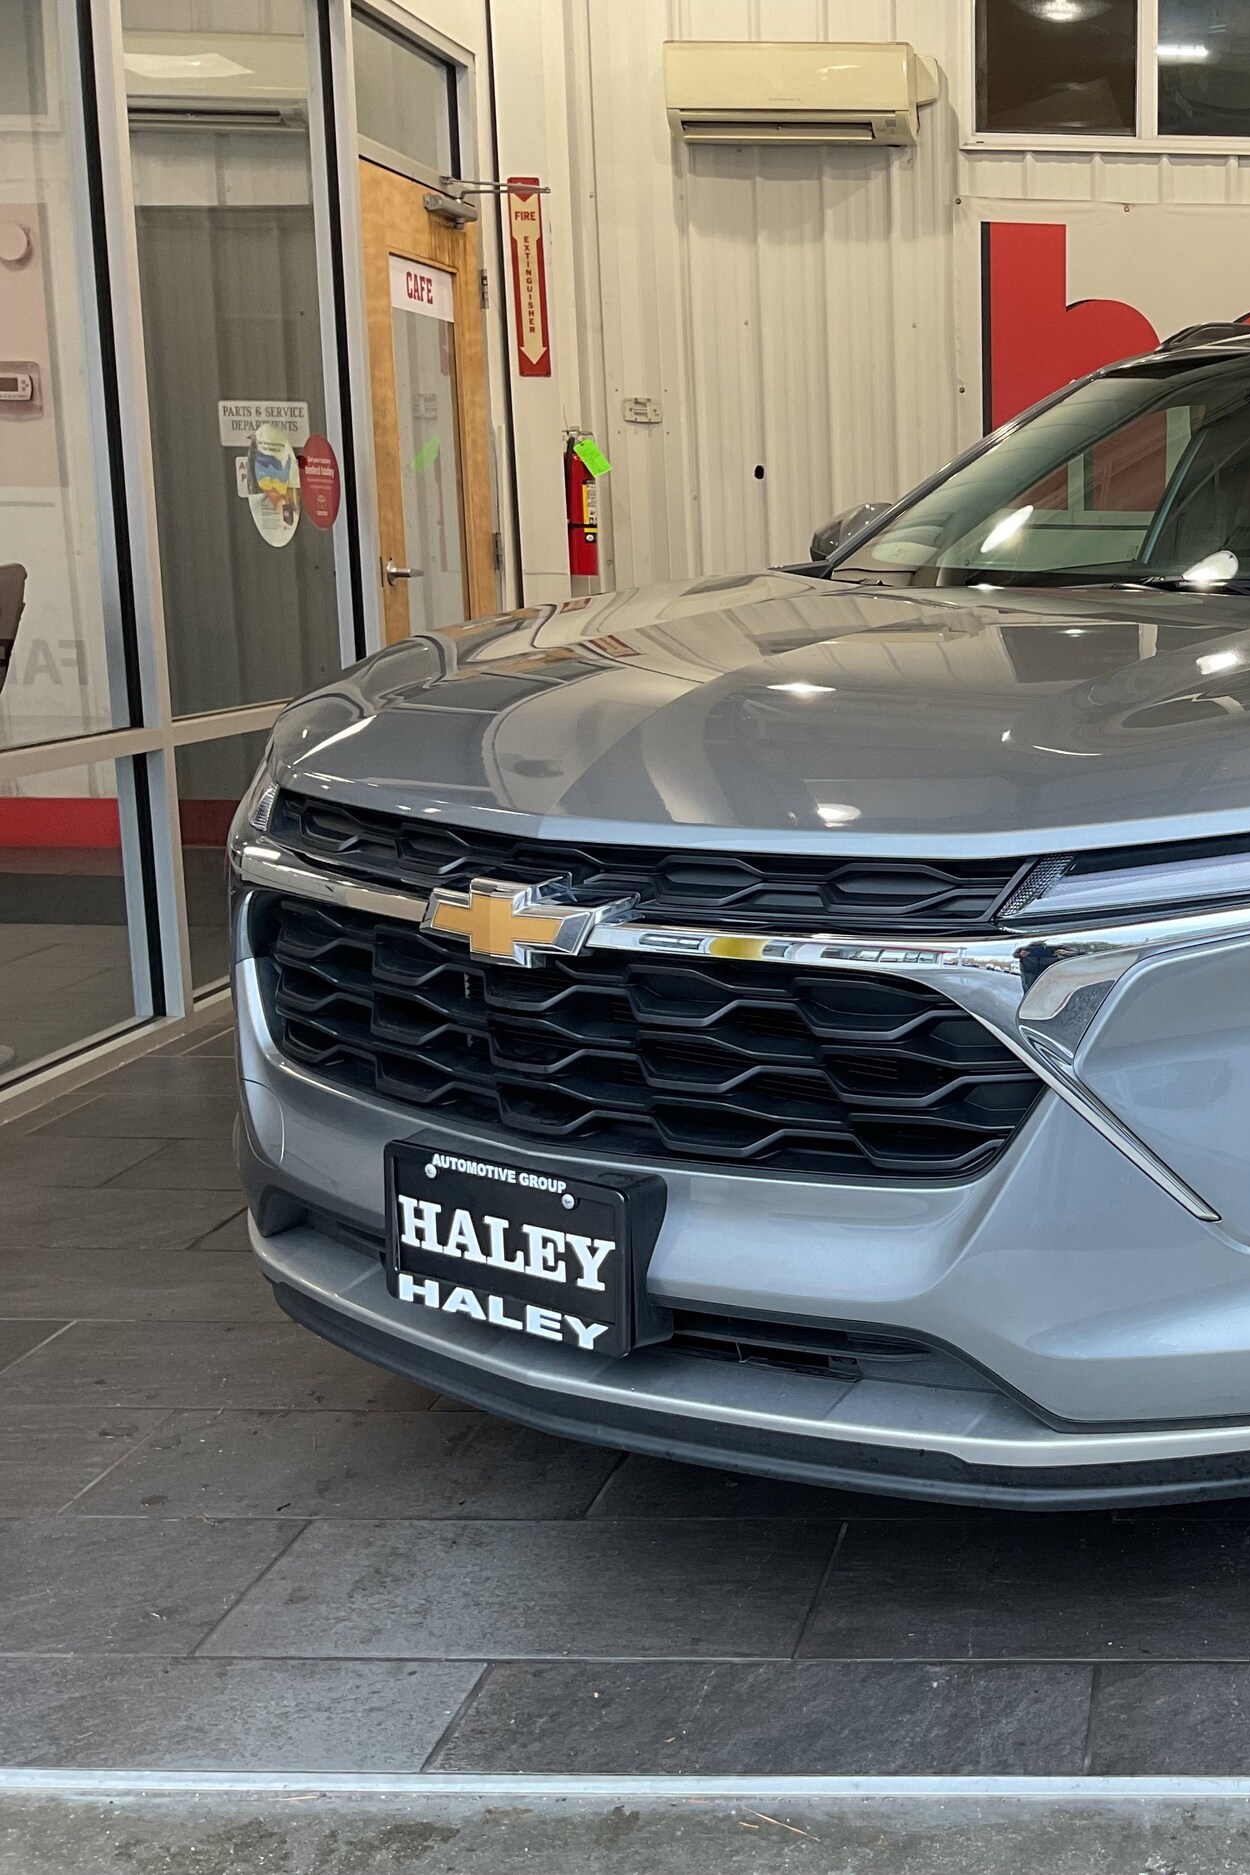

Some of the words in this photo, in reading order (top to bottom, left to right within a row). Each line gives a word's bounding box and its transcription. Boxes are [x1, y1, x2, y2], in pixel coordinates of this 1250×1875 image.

[514, 211, 536, 221] FIRE
[406, 271, 433, 304] CAFE
[524, 236, 535, 333] EXTINGUISHER
[223, 406, 252, 417] PARTS
[255, 406, 262, 417] &
[265, 406, 304, 418] SERVICE
[232, 420, 298, 432] DEPARENTS
[432, 1153, 517, 1184] AUTOMOTIVE
[518, 1172, 567, 1194] GROUP
[398, 1194, 616, 1292] HALEY
[398, 1273, 609, 1350] HALEY
